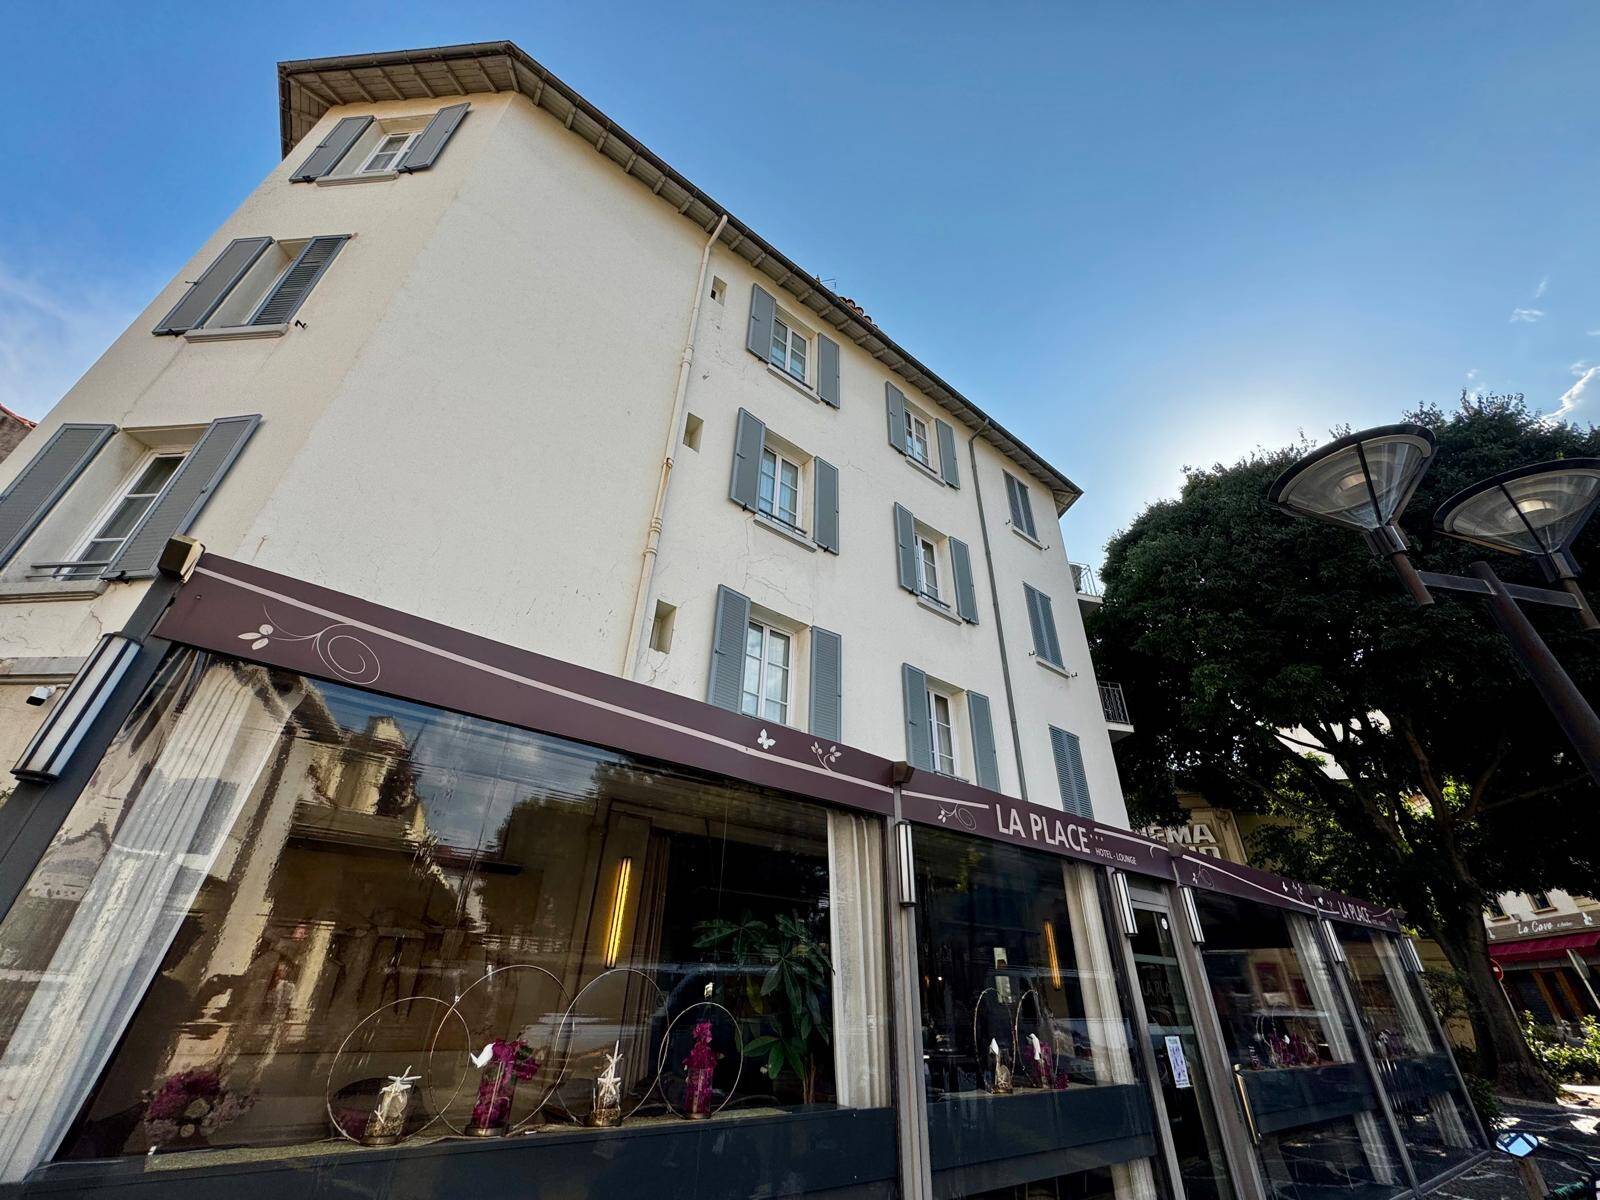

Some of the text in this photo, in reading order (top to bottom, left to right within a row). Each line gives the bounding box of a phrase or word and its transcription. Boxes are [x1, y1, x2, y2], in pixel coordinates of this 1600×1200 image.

[996, 804, 1026, 838] LA
[1095, 848, 1114, 860] HOTEL
[1116, 852, 1137, 865] LOUNGE
[1337, 900, 1352, 920] LA
[1348, 903, 1372, 924] PLACE
